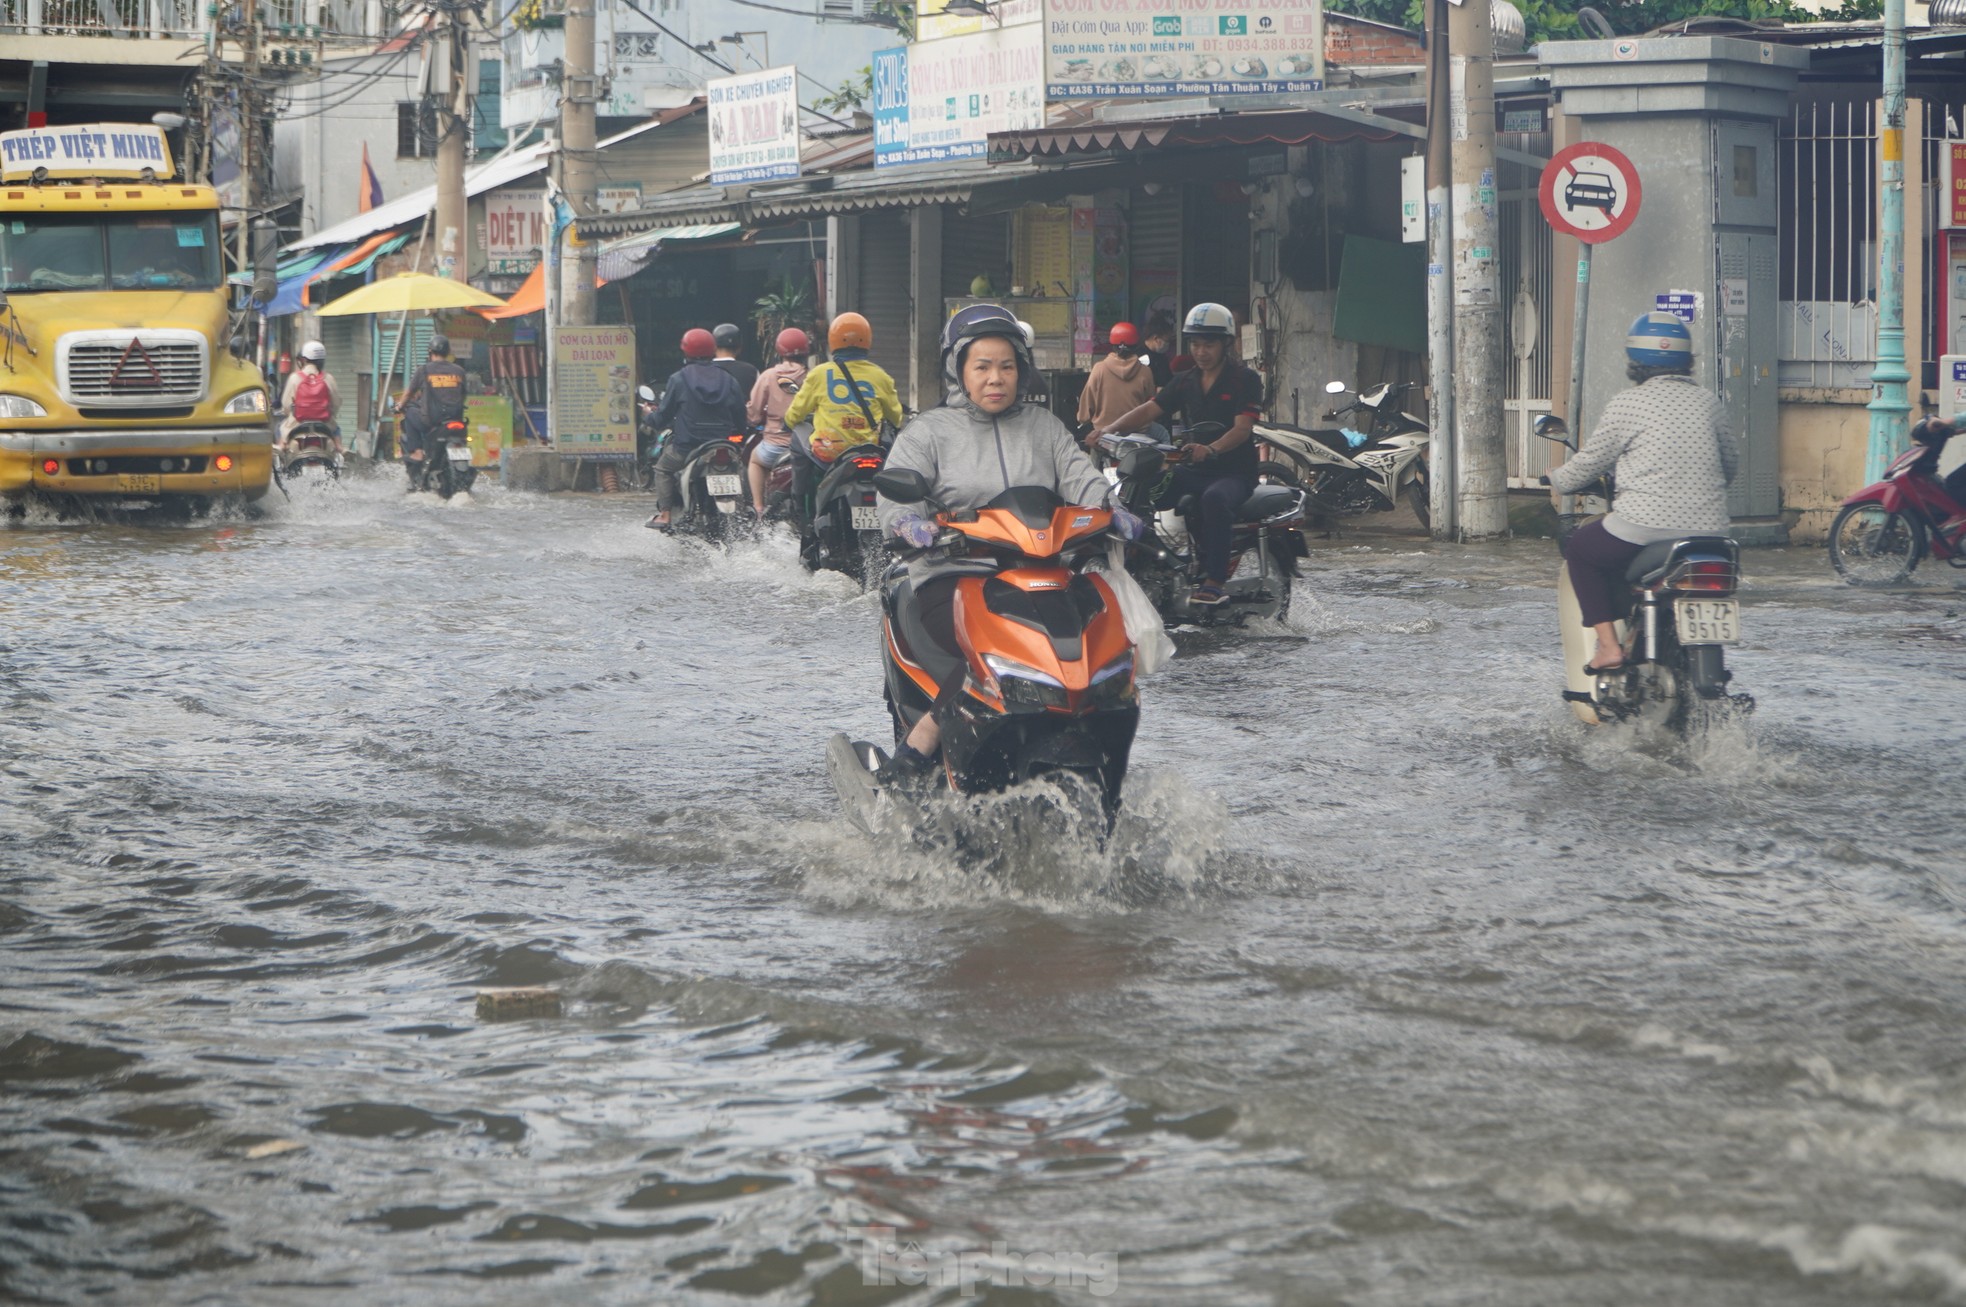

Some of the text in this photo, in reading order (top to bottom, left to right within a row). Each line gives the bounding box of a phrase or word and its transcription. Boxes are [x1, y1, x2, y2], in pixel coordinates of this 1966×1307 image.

[1052, 20, 1148, 37] Đặt Cơm Qua App:
[1154, 19, 1181, 33] Grab
[1052, 44, 1075, 55] GIAO
[1080, 42, 1105, 54] HÀNG
[1203, 39, 1314, 52] ĐT: 0934.388.832
[1009, 45, 1039, 82] LOAN
[710, 72, 793, 105] SƠN XE CHUYÊN NGHIỆP
[1050, 86, 1067, 96] ĐC:
[1069, 85, 1093, 95] KA36
[1118, 83, 1142, 94] Xuân
[1144, 83, 1167, 96] Soạn
[1212, 82, 1229, 93] Tân
[1232, 82, 1260, 94] Thuận
[1262, 82, 1278, 93] Tây
[1288, 82, 1311, 93] Quận
[1313, 82, 1320, 91] 7
[727, 101, 779, 145] A NAM
[877, 115, 909, 148] Print Shop
[3, 127, 163, 164] THÉP VIỆT MINH
[490, 205, 526, 251] DIỆT
[591, 350, 616, 361] LOAN
[826, 368, 876, 407] be
[1688, 621, 1731, 640] 9515
